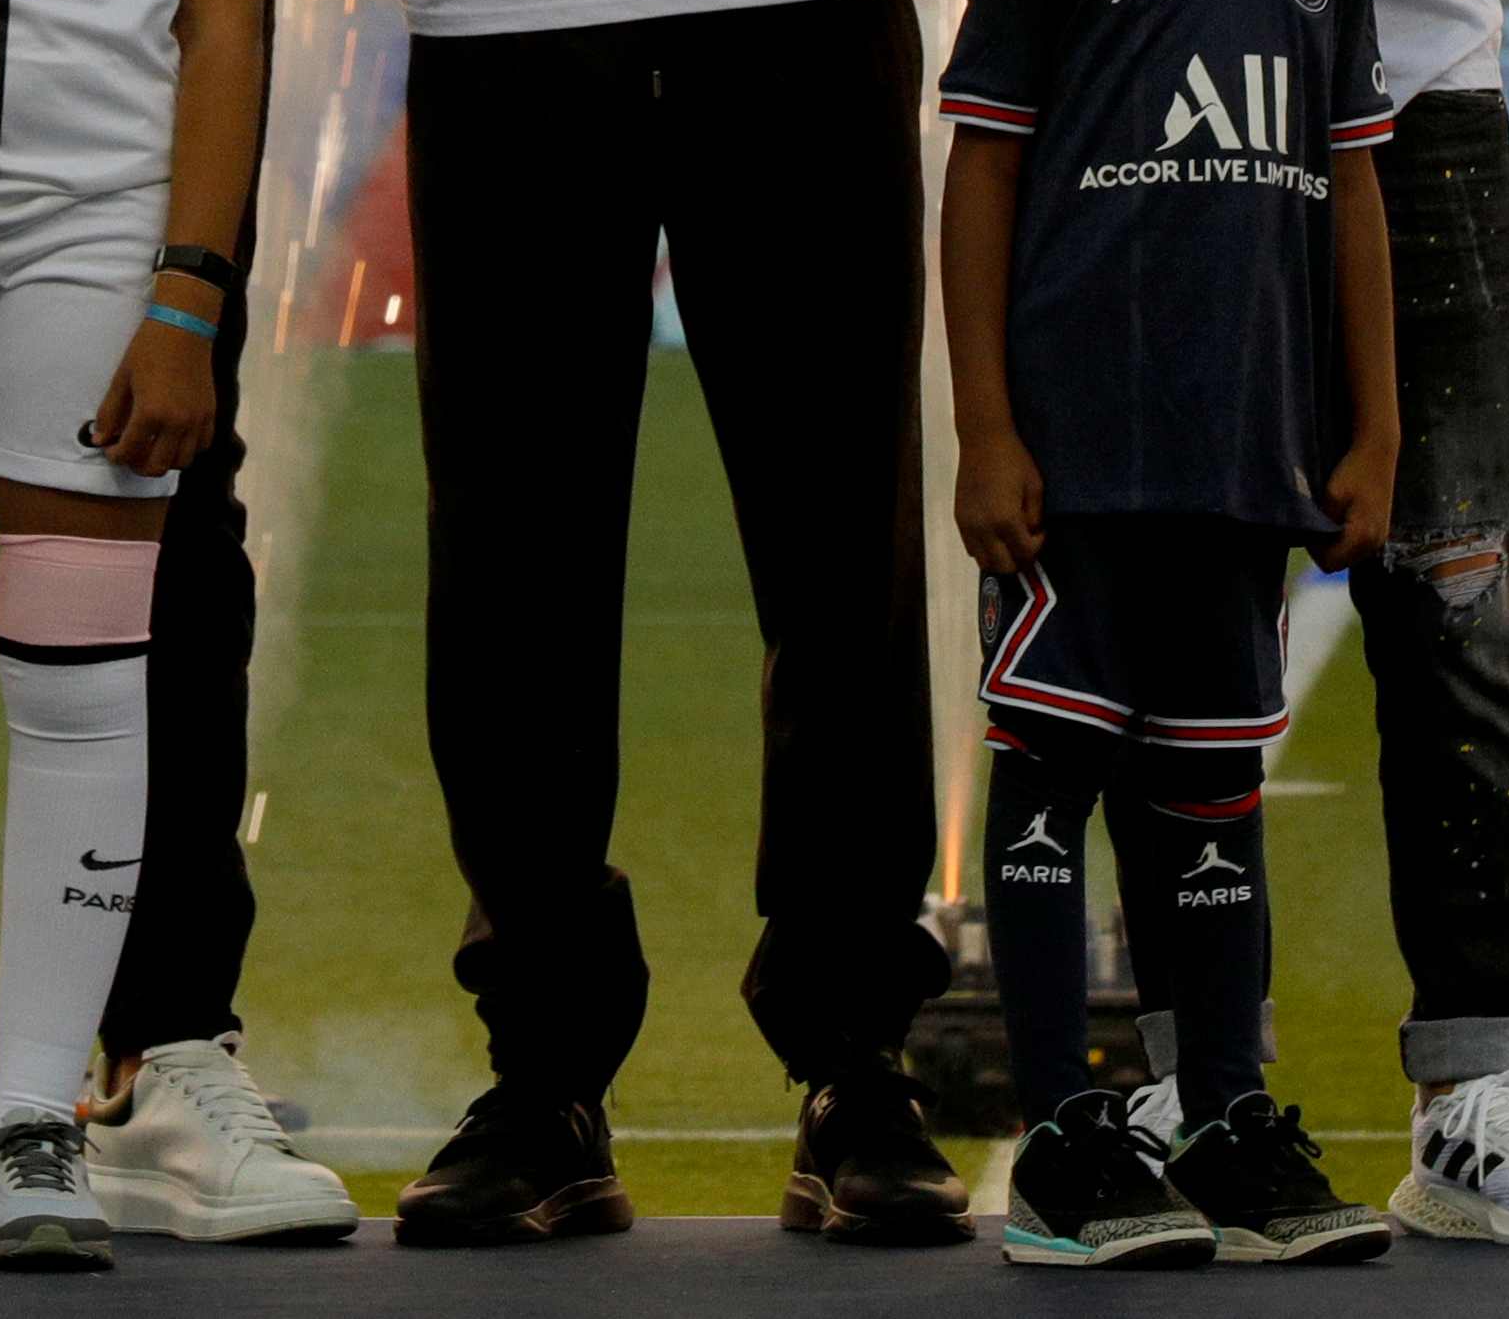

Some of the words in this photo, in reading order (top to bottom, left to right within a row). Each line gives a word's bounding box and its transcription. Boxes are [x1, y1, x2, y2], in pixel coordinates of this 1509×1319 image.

[1080, 160, 1181, 190] ACCOR
[1188, 159, 1248, 182] LIVE
[1002, 863, 1072, 885] PARIS
[1178, 884, 1252, 908] PARIS
